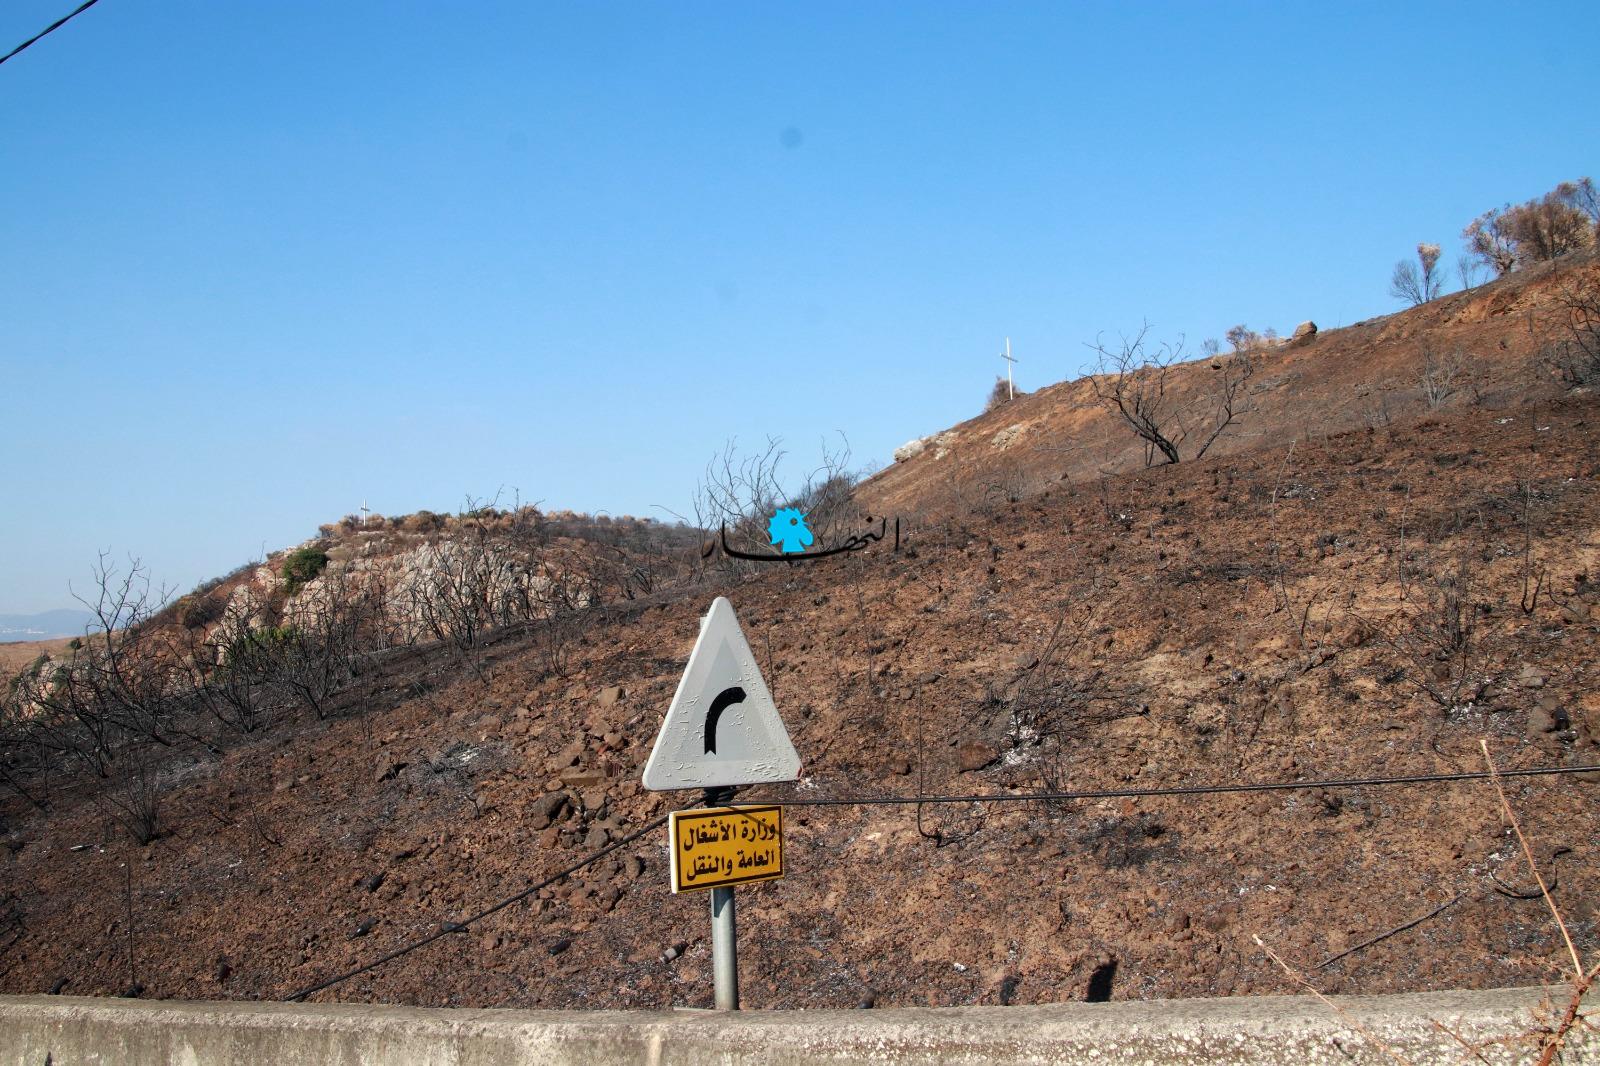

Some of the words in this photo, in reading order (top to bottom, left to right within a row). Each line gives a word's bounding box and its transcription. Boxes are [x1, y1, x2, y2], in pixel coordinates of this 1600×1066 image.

[683, 819, 736, 851] الأشغال
[741, 818, 776, 842] وزارة
[686, 855, 733, 881] والنقل
[736, 848, 775, 869] العامة
